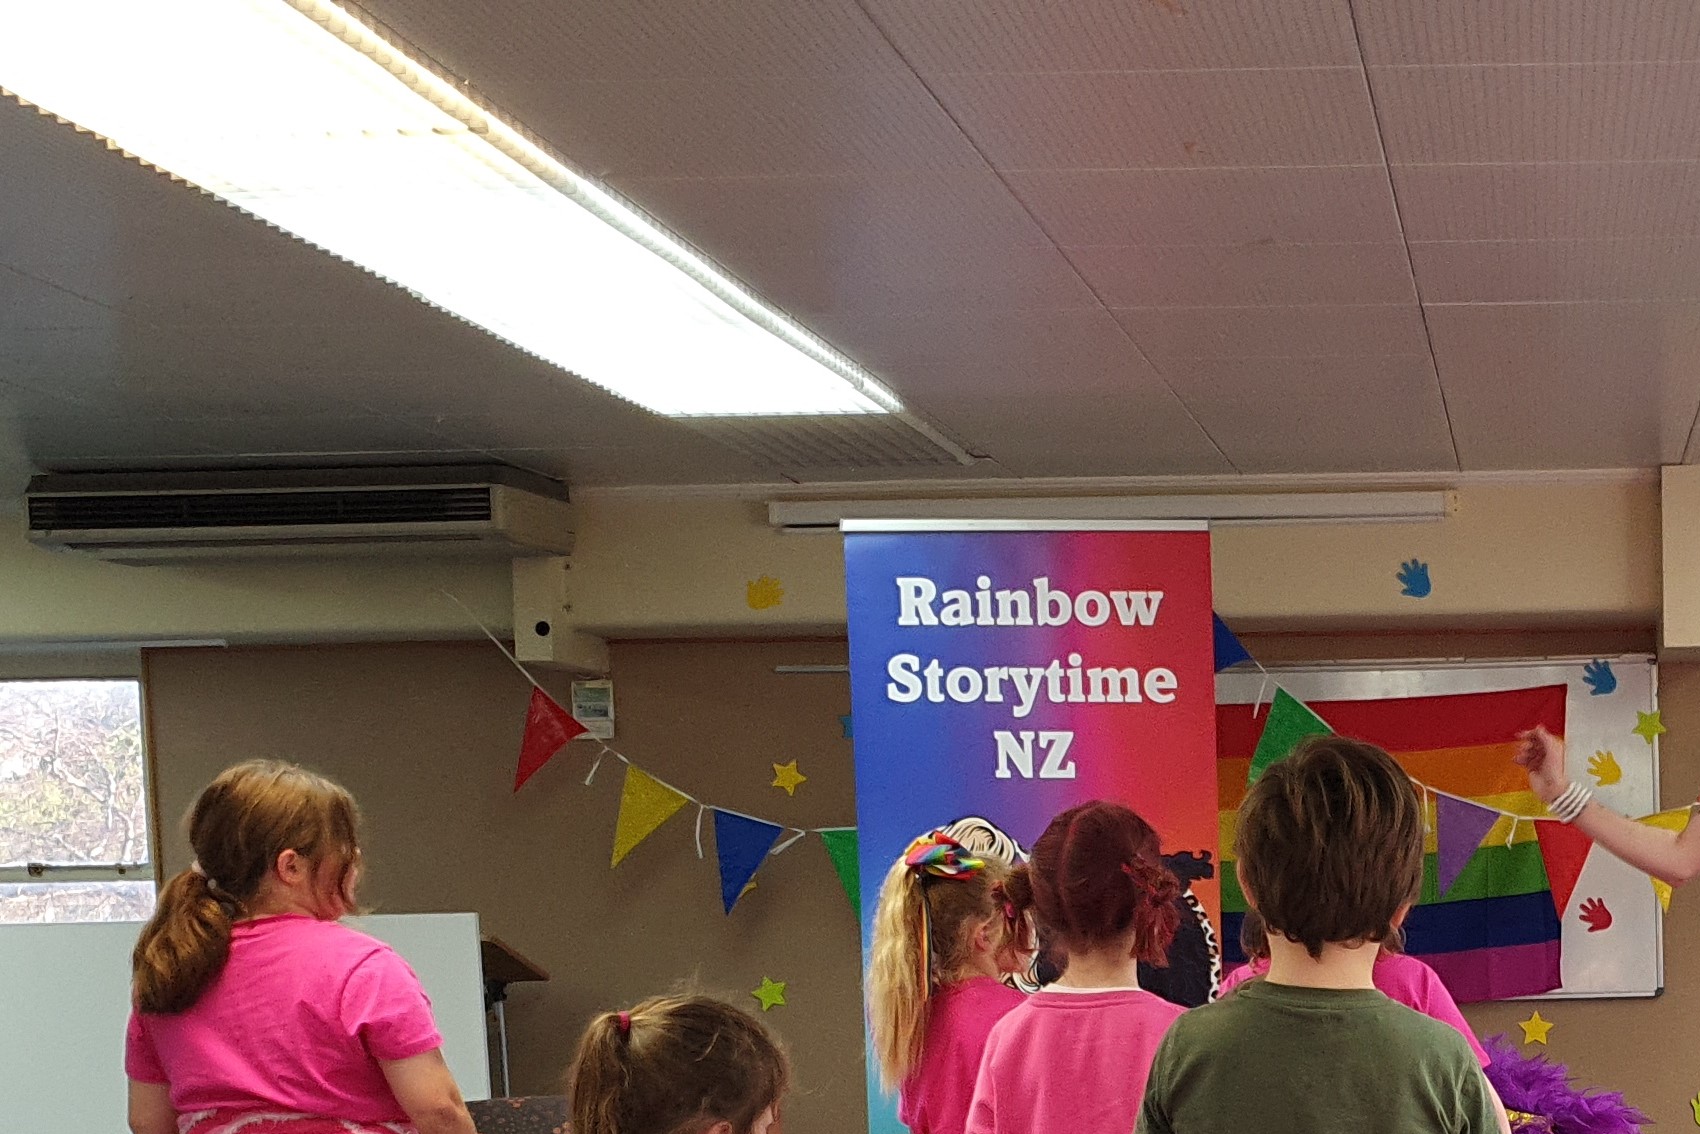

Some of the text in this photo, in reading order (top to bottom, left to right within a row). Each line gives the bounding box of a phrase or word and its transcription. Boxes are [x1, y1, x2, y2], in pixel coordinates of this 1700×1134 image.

[895, 575, 1164, 627] Rainbow
[886, 652, 1178, 718] Storytime
[993, 730, 1076, 779] NZ
